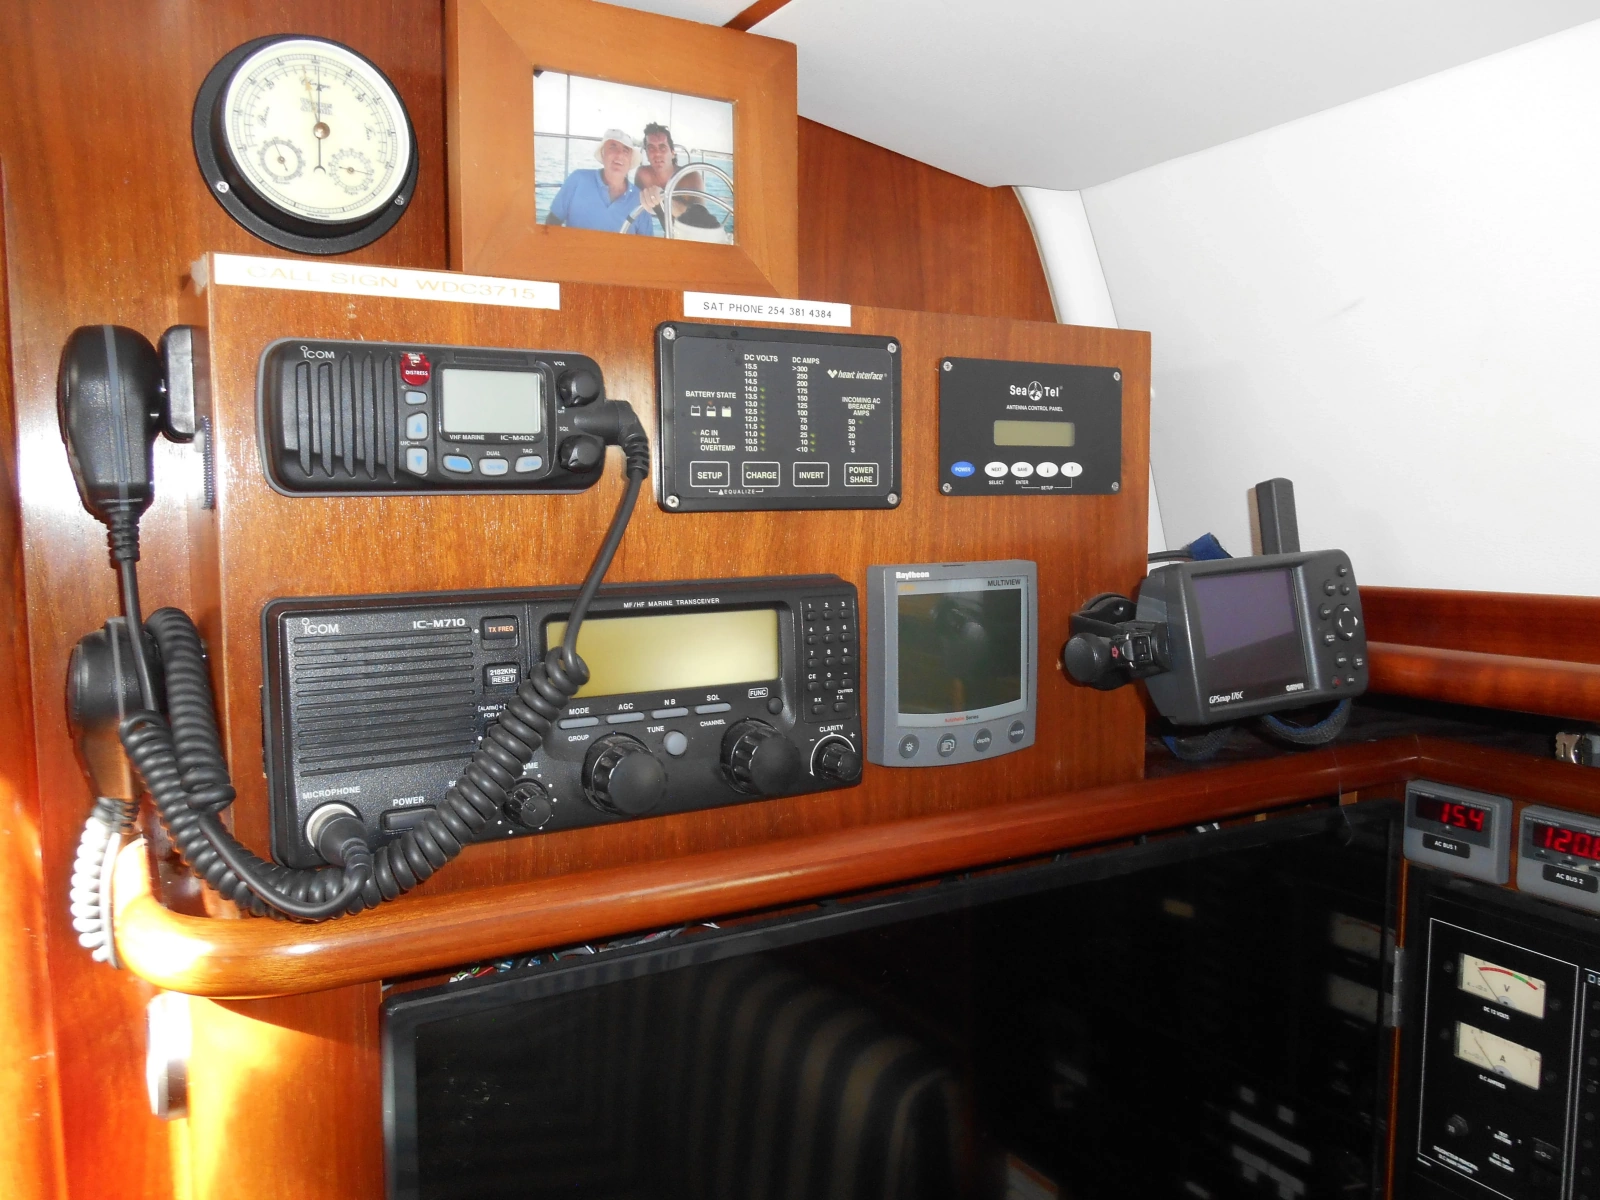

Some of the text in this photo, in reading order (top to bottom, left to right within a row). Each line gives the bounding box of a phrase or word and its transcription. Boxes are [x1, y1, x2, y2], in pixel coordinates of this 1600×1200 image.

[247, 264, 536, 300] CALL SIGN WDC3715
[703, 302, 832, 319] SAT PHONE 254 381 4384
[838, 370, 883, 380] heart interface
[1009, 384, 1059, 397] Sea Tel
[896, 571, 929, 580] Raytheon
[648, 599, 673, 608] MARINE
[676, 597, 720, 606] TRANSCEIVER
[413, 618, 465, 629] IC-M710
[750, 689, 767, 697] FUNC
[1209, 695, 1230, 704] GPSmap
[569, 706, 590, 715] MODE
[618, 702, 634, 711] AGC
[700, 719, 726, 727] CHANNEL
[819, 724, 844, 732] CLARITY
[568, 734, 589, 742] GROUP
[302, 786, 360, 800] MICROPHONE
[393, 796, 424, 806] POWER
